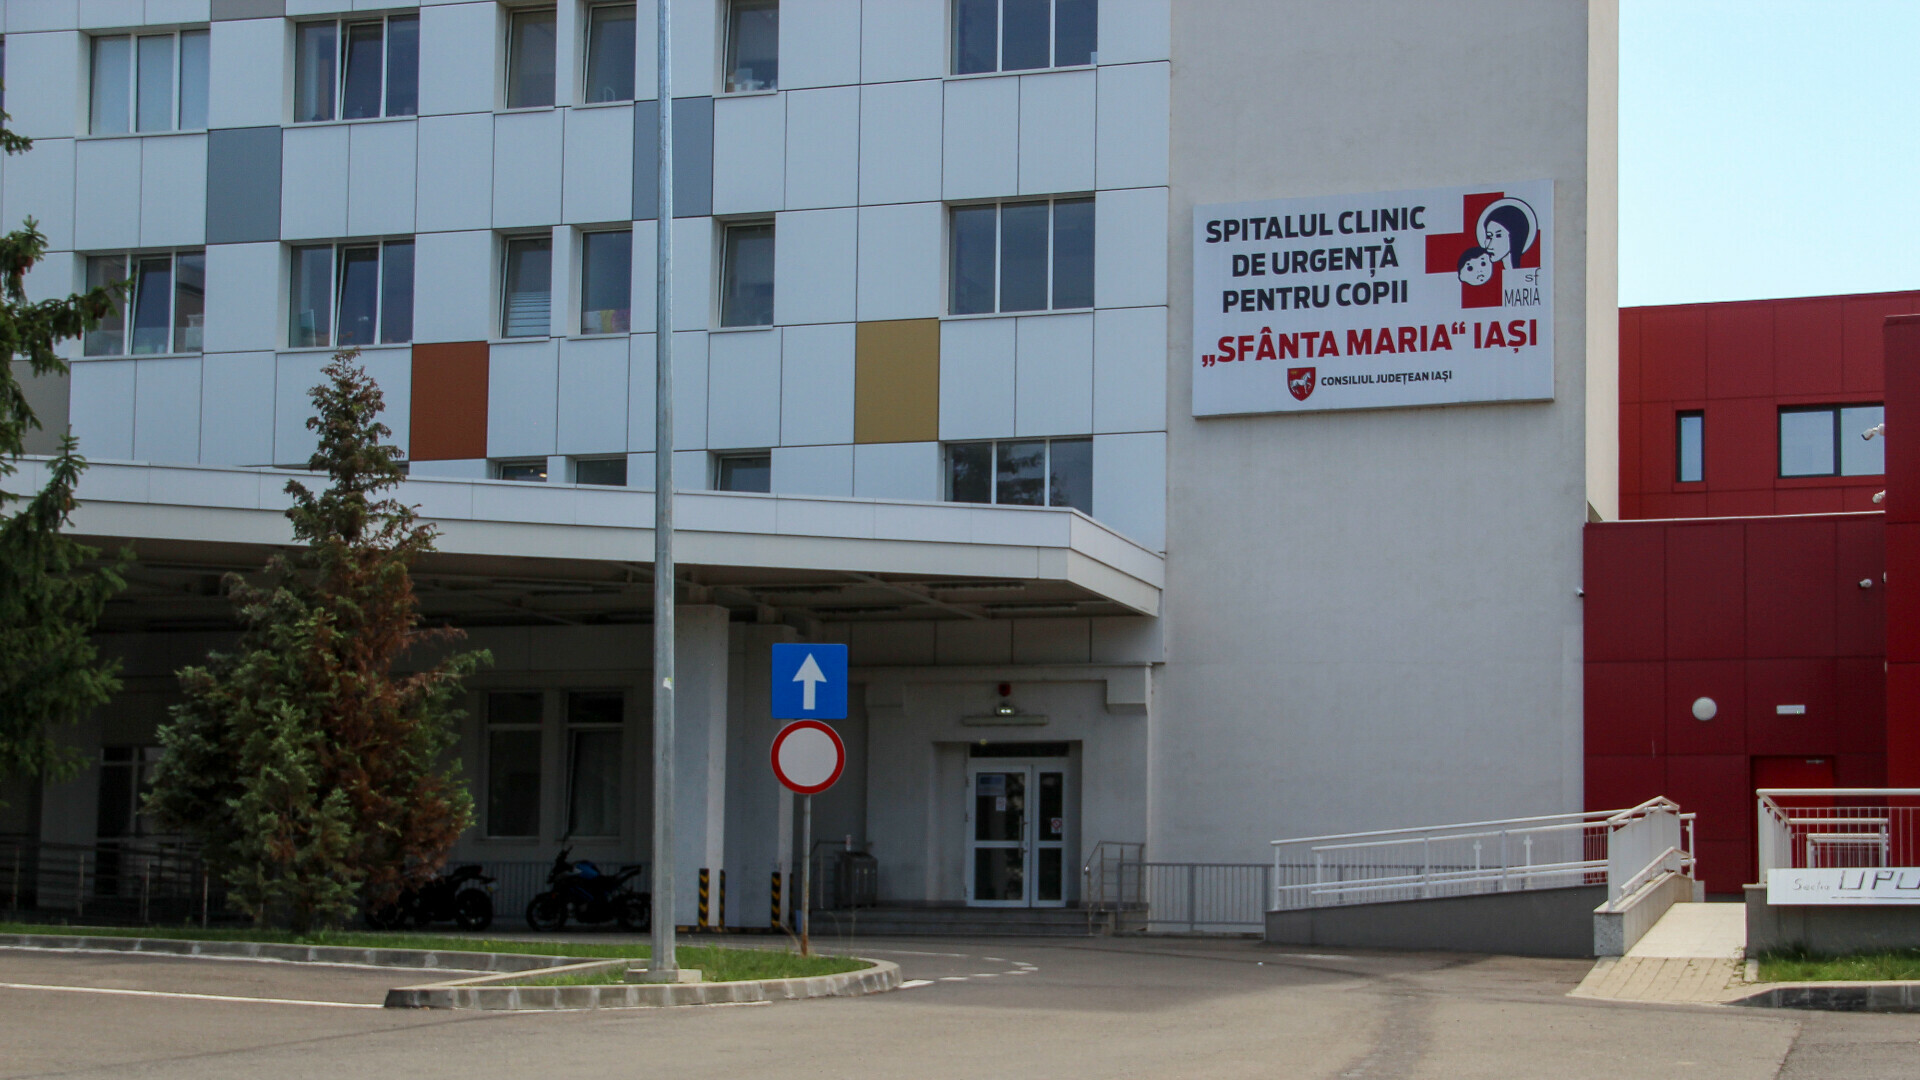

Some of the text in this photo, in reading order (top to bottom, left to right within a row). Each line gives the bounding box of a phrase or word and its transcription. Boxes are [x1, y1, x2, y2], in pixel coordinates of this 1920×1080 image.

[1205, 206, 1426, 244] SPITALUL CLINIC
[1232, 237, 1399, 278] DE URGENȚĂ
[1525, 267, 1541, 286] sf
[1222, 280, 1408, 313] PENTRU COPII
[1504, 287, 1541, 307] MARIA
[1201, 326, 1340, 367] „SFÂNTA
[1473, 319, 1537, 354] IAȘI
[1321, 370, 1452, 386] CONSILIUL JUDEȚEAN IAȘI
